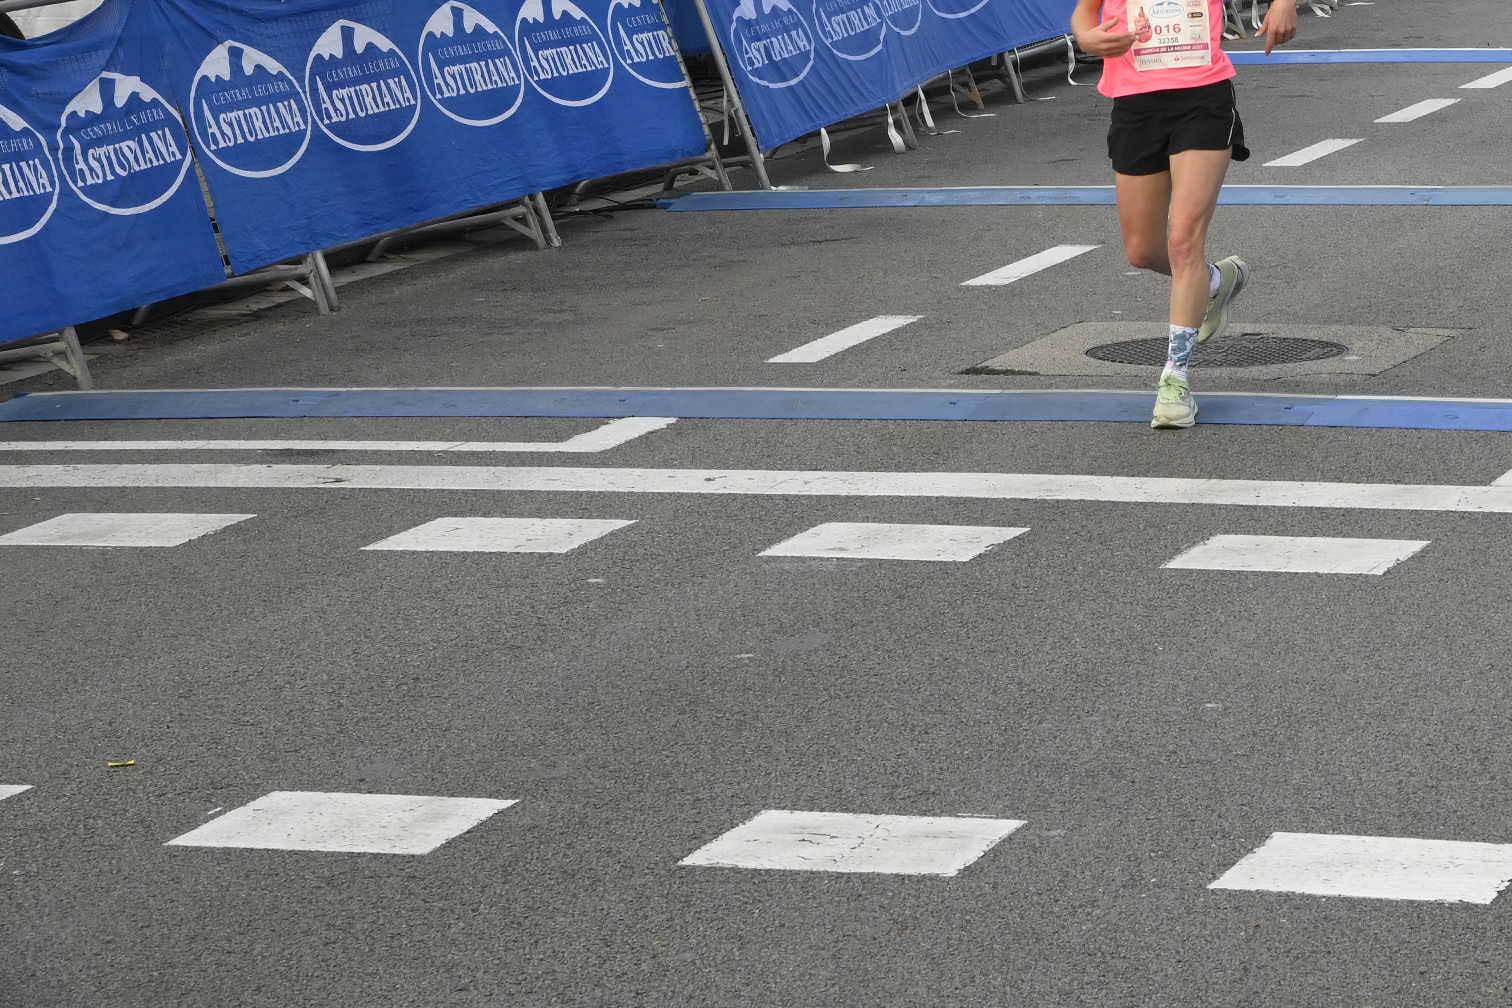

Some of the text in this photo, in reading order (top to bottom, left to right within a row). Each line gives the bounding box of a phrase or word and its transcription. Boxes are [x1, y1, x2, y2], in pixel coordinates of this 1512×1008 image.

[627, 13, 658, 28] CENTRAL
[1154, 23, 1182, 35] 016
[531, 25, 593, 44] CENTRAL LECHERA
[617, 21, 678, 65] ASTUR
[438, 39, 504, 59] CENTRAL LECHERA
[524, 36, 609, 81] ASTURIANA
[326, 57, 400, 82] CENTRAL LECHERA
[428, 52, 520, 100] ASTURIANA
[213, 79, 289, 106] CENTRAL LECHERA
[316, 75, 416, 125] ASTURIANA
[81, 122, 123, 140] CENTRAL
[202, 98, 305, 151] ASTURIANA
[0, 138, 34, 154] ECHERA
